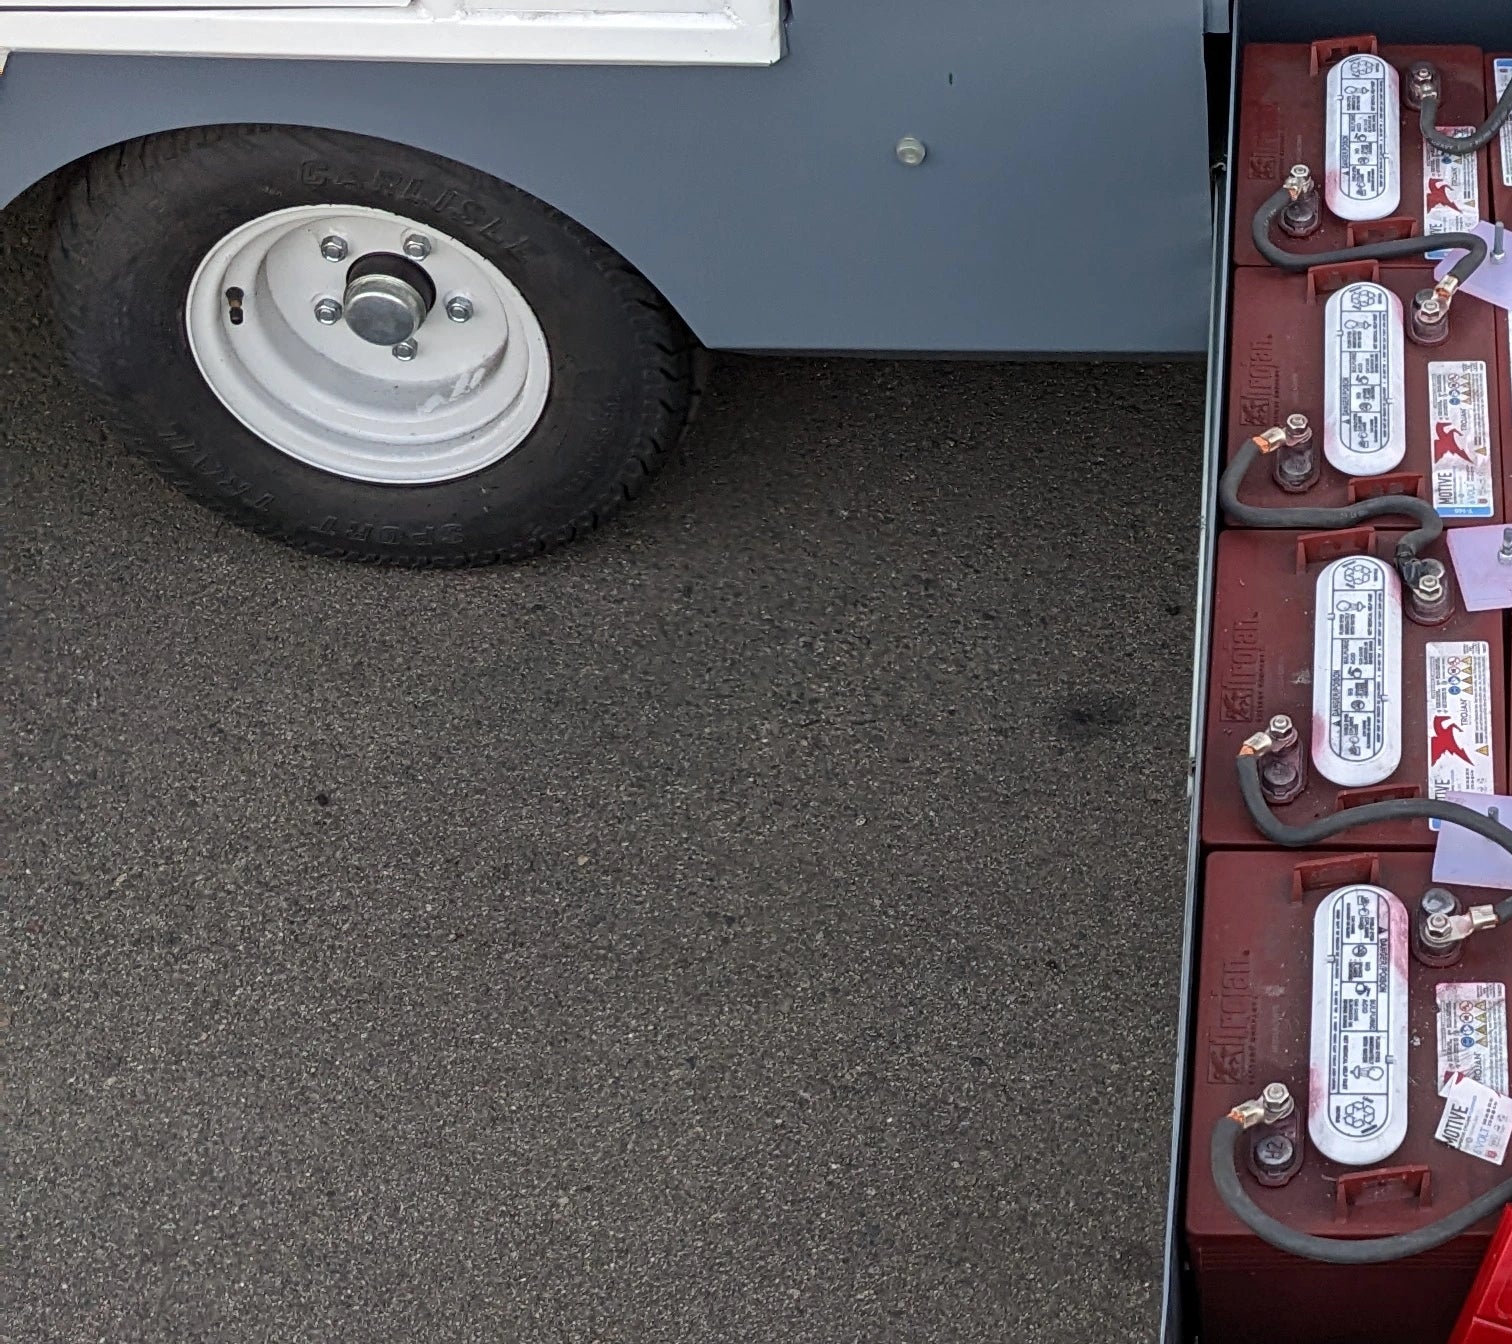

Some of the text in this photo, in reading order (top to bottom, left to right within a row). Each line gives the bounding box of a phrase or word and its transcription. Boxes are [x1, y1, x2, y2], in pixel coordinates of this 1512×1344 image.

[1460, 407, 1469, 431] TROJAN
[1437, 472, 1456, 505] MOTIVE
[1459, 698, 1469, 727] TROJAN
[1441, 1103, 1470, 1145] MOTIVE
